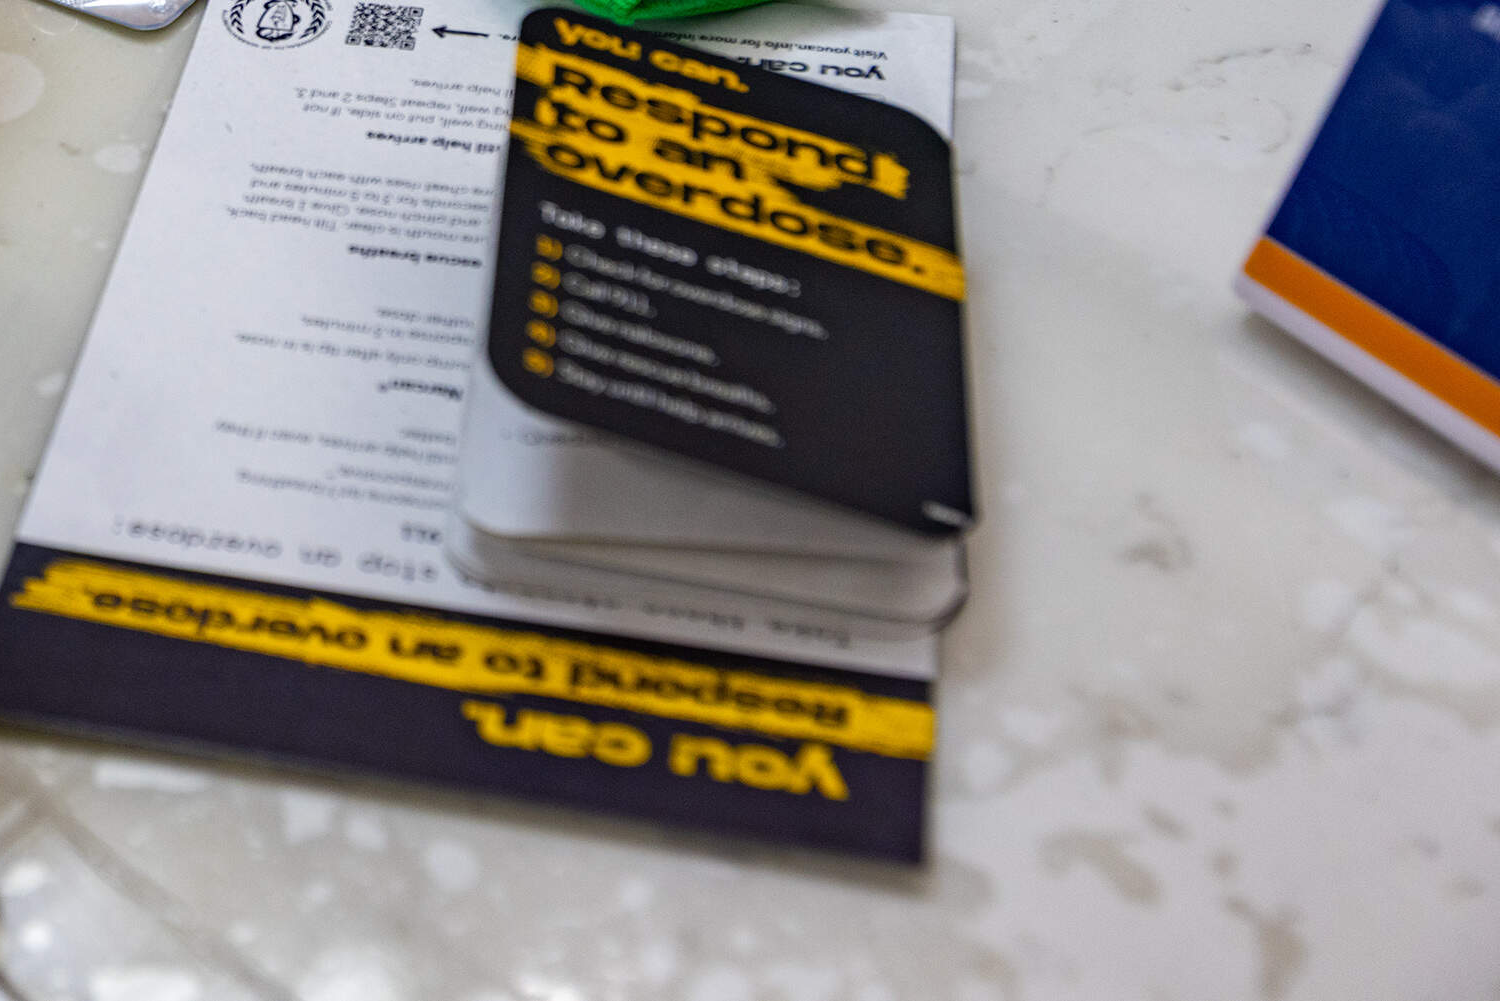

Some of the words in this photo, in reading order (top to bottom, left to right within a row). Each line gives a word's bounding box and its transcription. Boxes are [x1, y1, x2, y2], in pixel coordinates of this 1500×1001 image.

[699, 33, 738, 44] more
[741, 39, 762, 48] for
[553, 17, 641, 61] you
[649, 49, 750, 94] can.
[764, 40, 851, 56] youcan.info
[853, 50, 888, 60] Visit
[820, 64, 886, 81] you
[292, 85, 309, 100] 3.
[310, 86, 341, 102] and
[409, 78, 464, 93] arrives.
[465, 82, 502, 97] help
[341, 91, 354, 105] 2
[355, 91, 398, 110] Steps
[399, 95, 452, 113] repeat
[302, 102, 330, 116] not
[345, 106, 383, 123] side.
[385, 109, 406, 122] on
[454, 100, 491, 116] well,
[407, 112, 436, 127] put
[438, 114, 474, 130] well,
[551, 62, 878, 180] Respond
[366, 130, 429, 149] arrives
[431, 135, 473, 153] help
[475, 141, 502, 156] til
[556, 100, 625, 144] to
[654, 138, 746, 180] an
[308, 167, 347, 185] each
[349, 172, 383, 189] with
[386, 177, 422, 192] rises
[248, 178, 282, 193] and
[283, 180, 348, 199] minutes
[423, 180, 469, 197] chest
[242, 192, 295, 211] breath
[310, 200, 350, 218] Give
[546, 144, 926, 275] overdose.
[269, 213, 312, 229] head
[401, 208, 447, 226] pinch
[404, 225, 460, 243] mouth
[346, 244, 422, 266] breaths
[616, 225, 698, 267] these
[425, 253, 484, 271] escue
[110, 516, 283, 563] overdose:
[297, 546, 342, 570] an
[357, 550, 439, 585] stop
[82, 588, 367, 651] overdose.
[389, 634, 461, 668] an
[484, 651, 546, 683] to
[569, 660, 850, 730] Respond
[462, 700, 652, 767] can.
[667, 733, 850, 801] you
